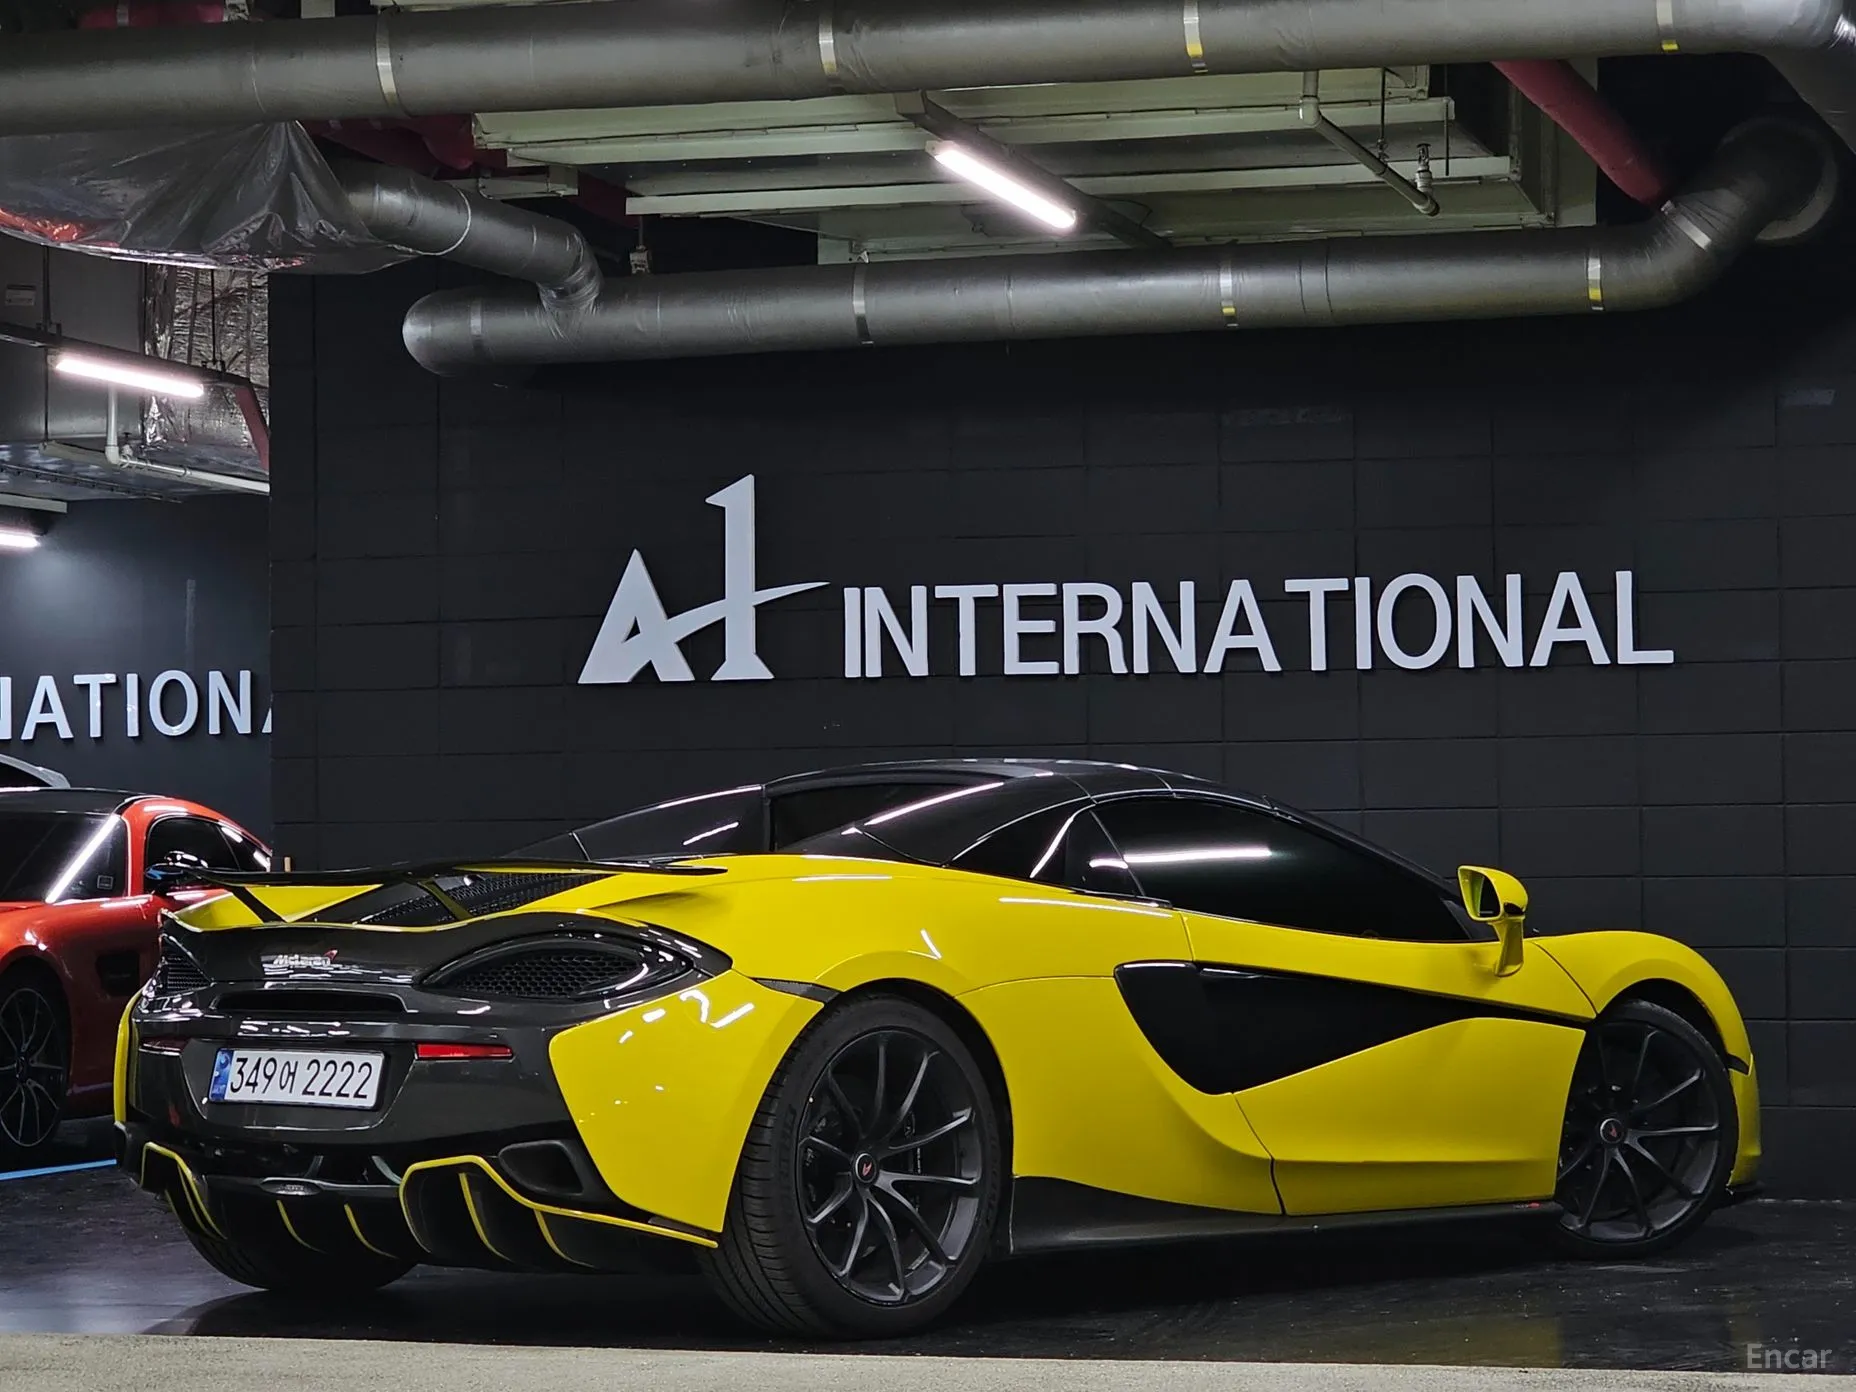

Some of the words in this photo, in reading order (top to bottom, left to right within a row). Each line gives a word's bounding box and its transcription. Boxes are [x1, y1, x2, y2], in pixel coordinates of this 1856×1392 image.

[578, 474, 830, 684] A1
[843, 570, 1674, 678] INTERNATIONAL
[0, 669, 272, 740] ATION
[302, 1059, 373, 1099] 2222
